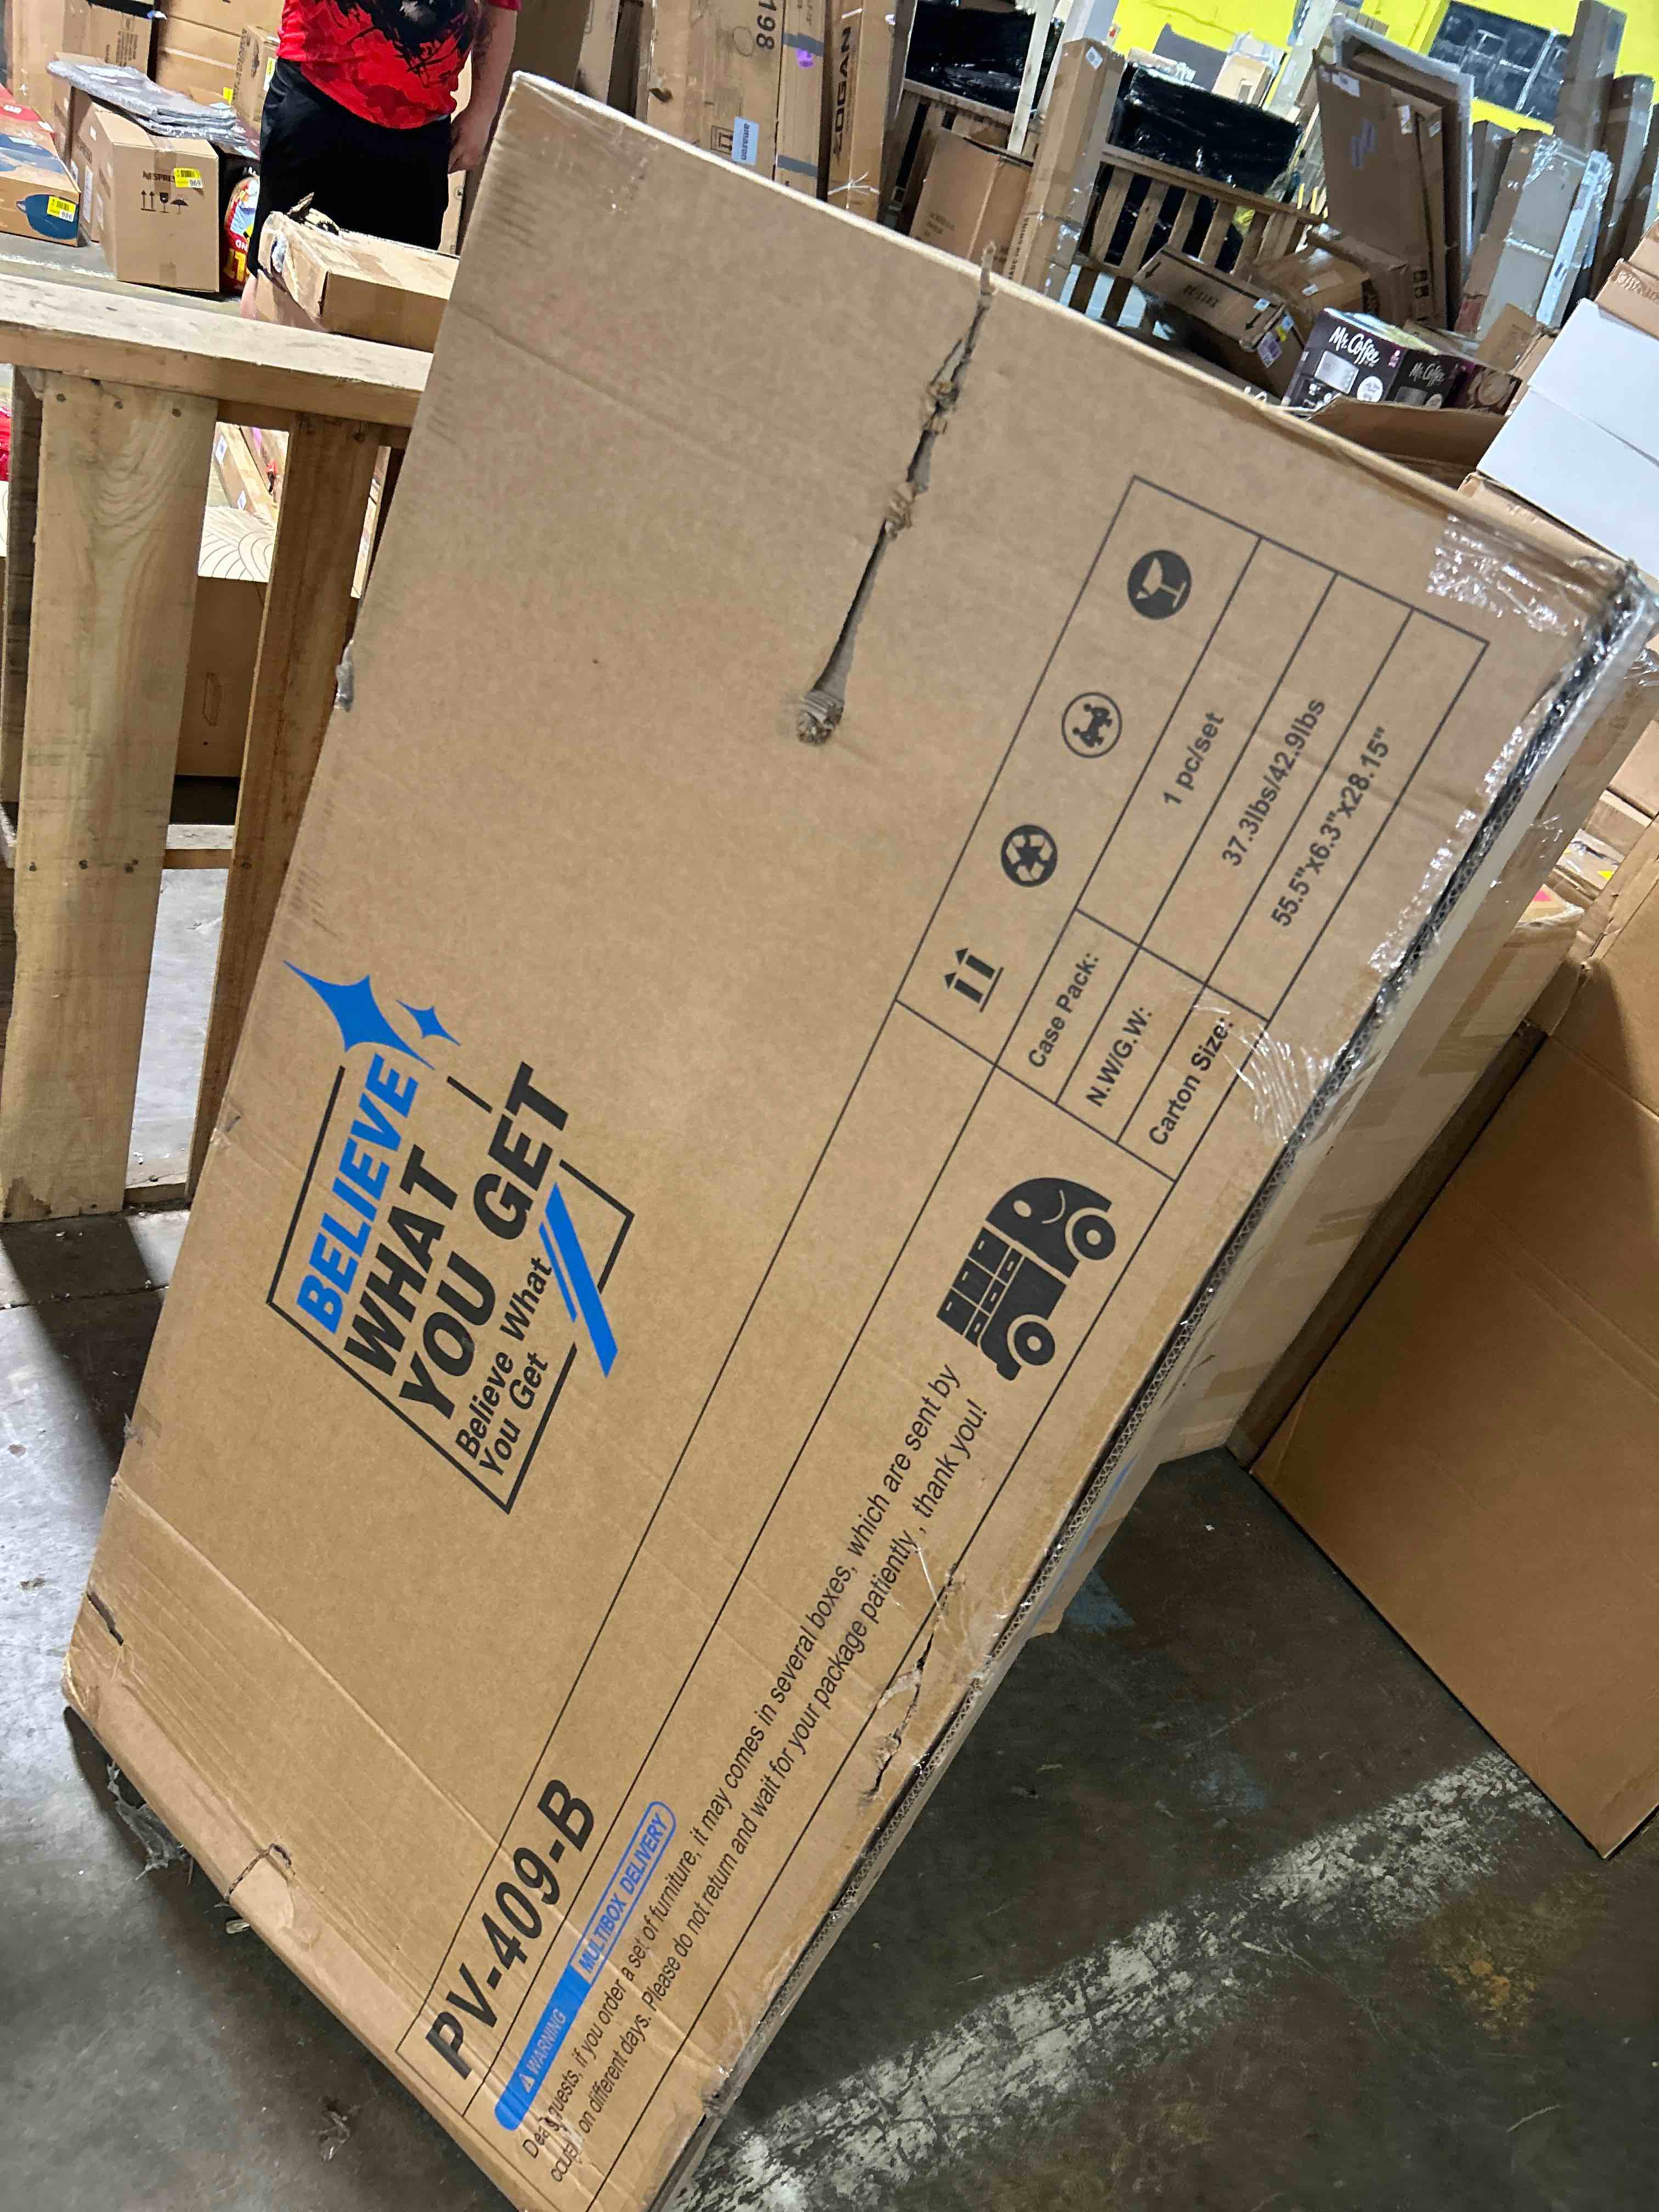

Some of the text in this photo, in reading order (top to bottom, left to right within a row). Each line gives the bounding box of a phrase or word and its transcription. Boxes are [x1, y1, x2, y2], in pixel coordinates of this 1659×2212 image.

[741, 123, 750, 160] amazon
[1329, 326, 1379, 364] Mr. Coffee
[1163, 712, 1224, 805] 1 pc/set
[1222, 699, 1325, 866] 37.3lbs/42.9lbs
[1028, 952, 1099, 1068] Case Pack:
[1085, 1007, 1152, 1107] N.W/G.W:
[1149, 1017, 1234, 1146] Carton Size:
[296, 1053, 419, 1334] BELIEVE
[343, 1144, 458, 1377] WHAT
[399, 1061, 569, 1420] YOU GET
[455, 1256, 552, 1460] Believe What
[927, 1364, 960, 1398] by
[479, 1351, 549, 1479] You Get
[905, 1396, 941, 1451] sent
[883, 1453, 910, 1492] are
[847, 1494, 889, 1556] which
[805, 1566, 857, 1629] boxes,
[770, 1625, 817, 1703] several
[754, 1704, 776, 1726] in
[578, 2111, 595, 2133] on
[588, 2050, 627, 2113] different
[619, 2014, 652, 2054] days.
[641, 1956, 680, 2011] Please
[672, 1933, 692, 1957] do
[686, 1901, 710, 1935] not
[702, 1853, 737, 1906] return
[731, 1812, 757, 1854] and
[750, 1774, 780, 1816] wait
[769, 1747, 794, 1779] for
[788, 1702, 820, 1755] your
[814, 1621, 866, 1709] package
[860, 1530, 918, 1624] patiently
[912, 1453, 959, 1517] thank
[949, 1398, 987, 1459] you!
[725, 1725, 764, 1788] comes
[689, 1826, 708, 1846] it
[701, 1787, 732, 1831] may
[578, 1812, 669, 1974] MULTIBOX DELIVERY
[649, 1850, 702, 1922] furniture,
[425, 1779, 595, 2080] PV-409-B
[628, 1937, 650, 1967] set
[642, 1914, 658, 1940] of
[598, 1978, 626, 2025] order
[621, 1967, 635, 1983] a
[526, 2008, 567, 2075] WARNING
[571, 2047, 588, 2068] if
[581, 2023, 603, 2059] you
